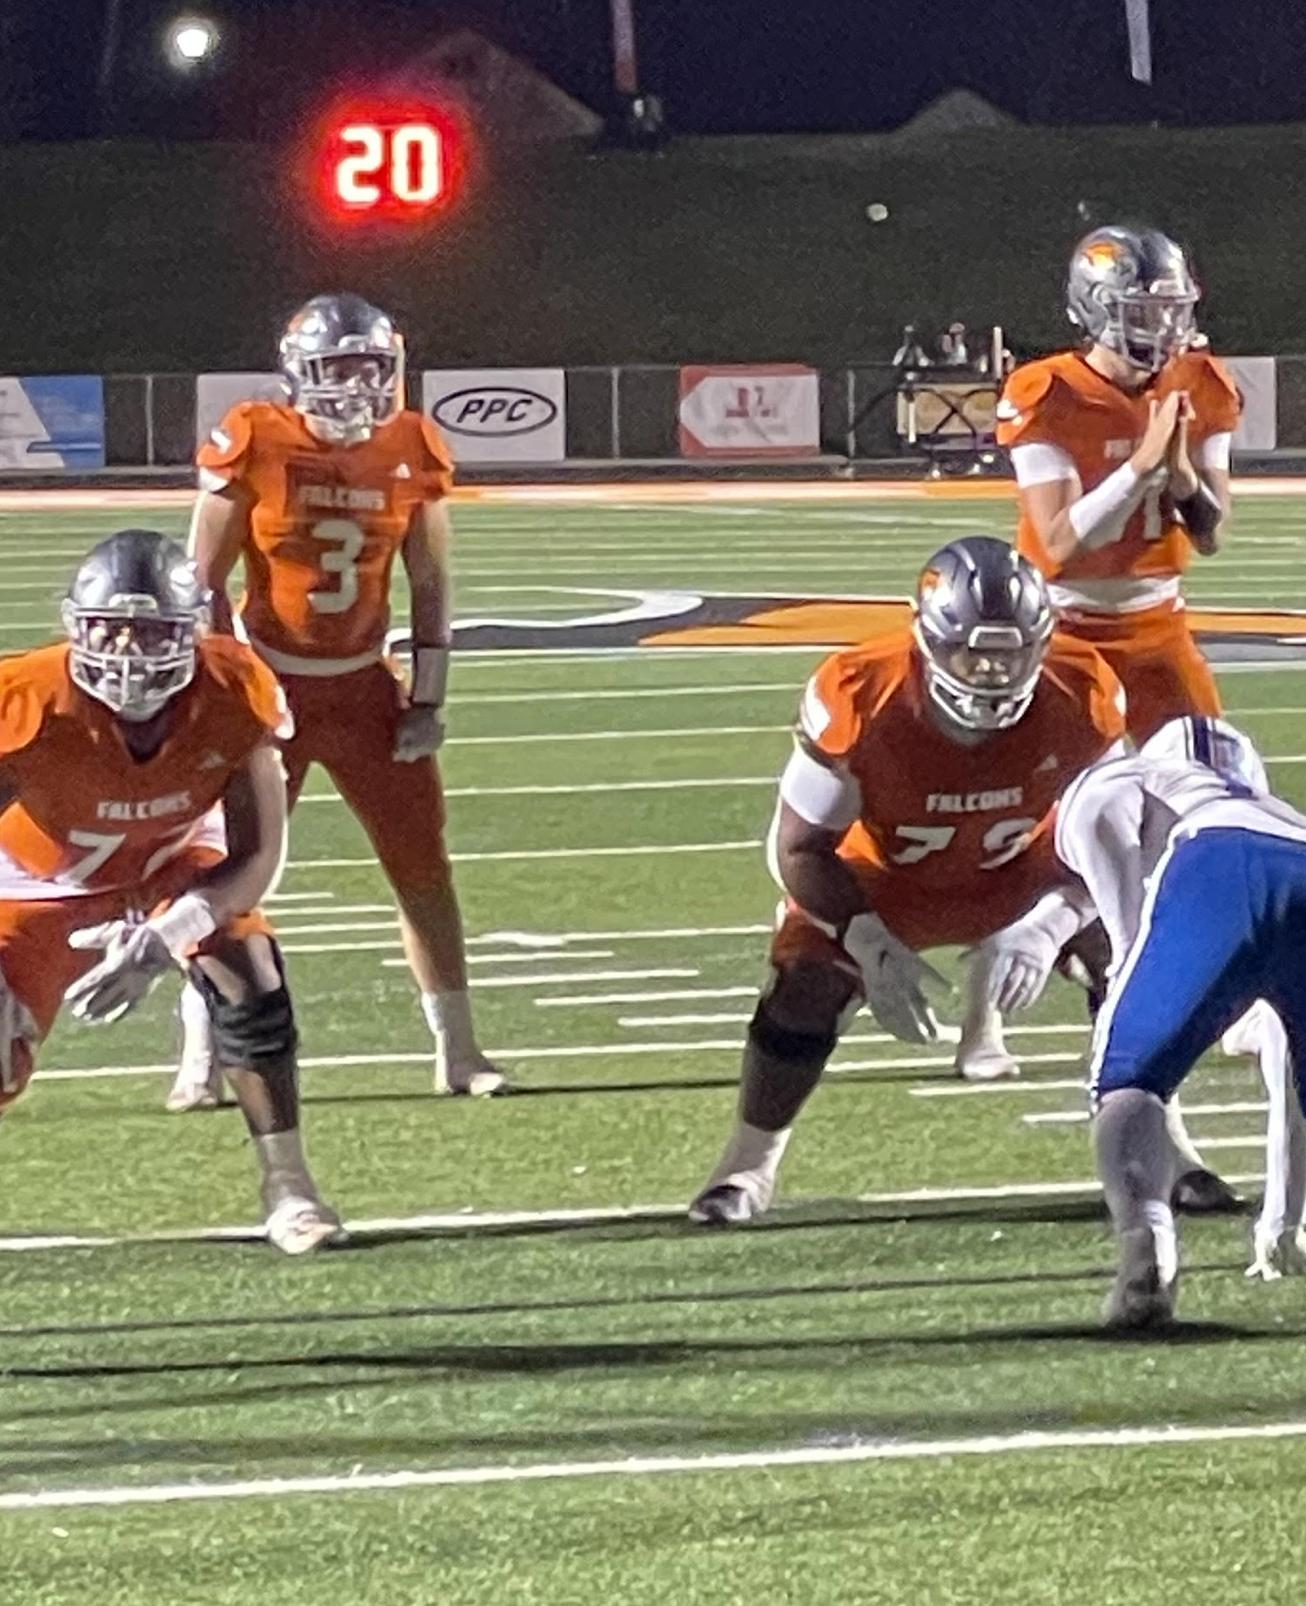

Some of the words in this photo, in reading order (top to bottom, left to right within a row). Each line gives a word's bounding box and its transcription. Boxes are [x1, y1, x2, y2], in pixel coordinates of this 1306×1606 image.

[337, 124, 442, 203] 20
[456, 398, 533, 423] PPC
[299, 485, 385, 511] FALCONS
[309, 519, 364, 614] 3
[97, 791, 191, 820] FALCONS
[926, 786, 1023, 813] FALCONS
